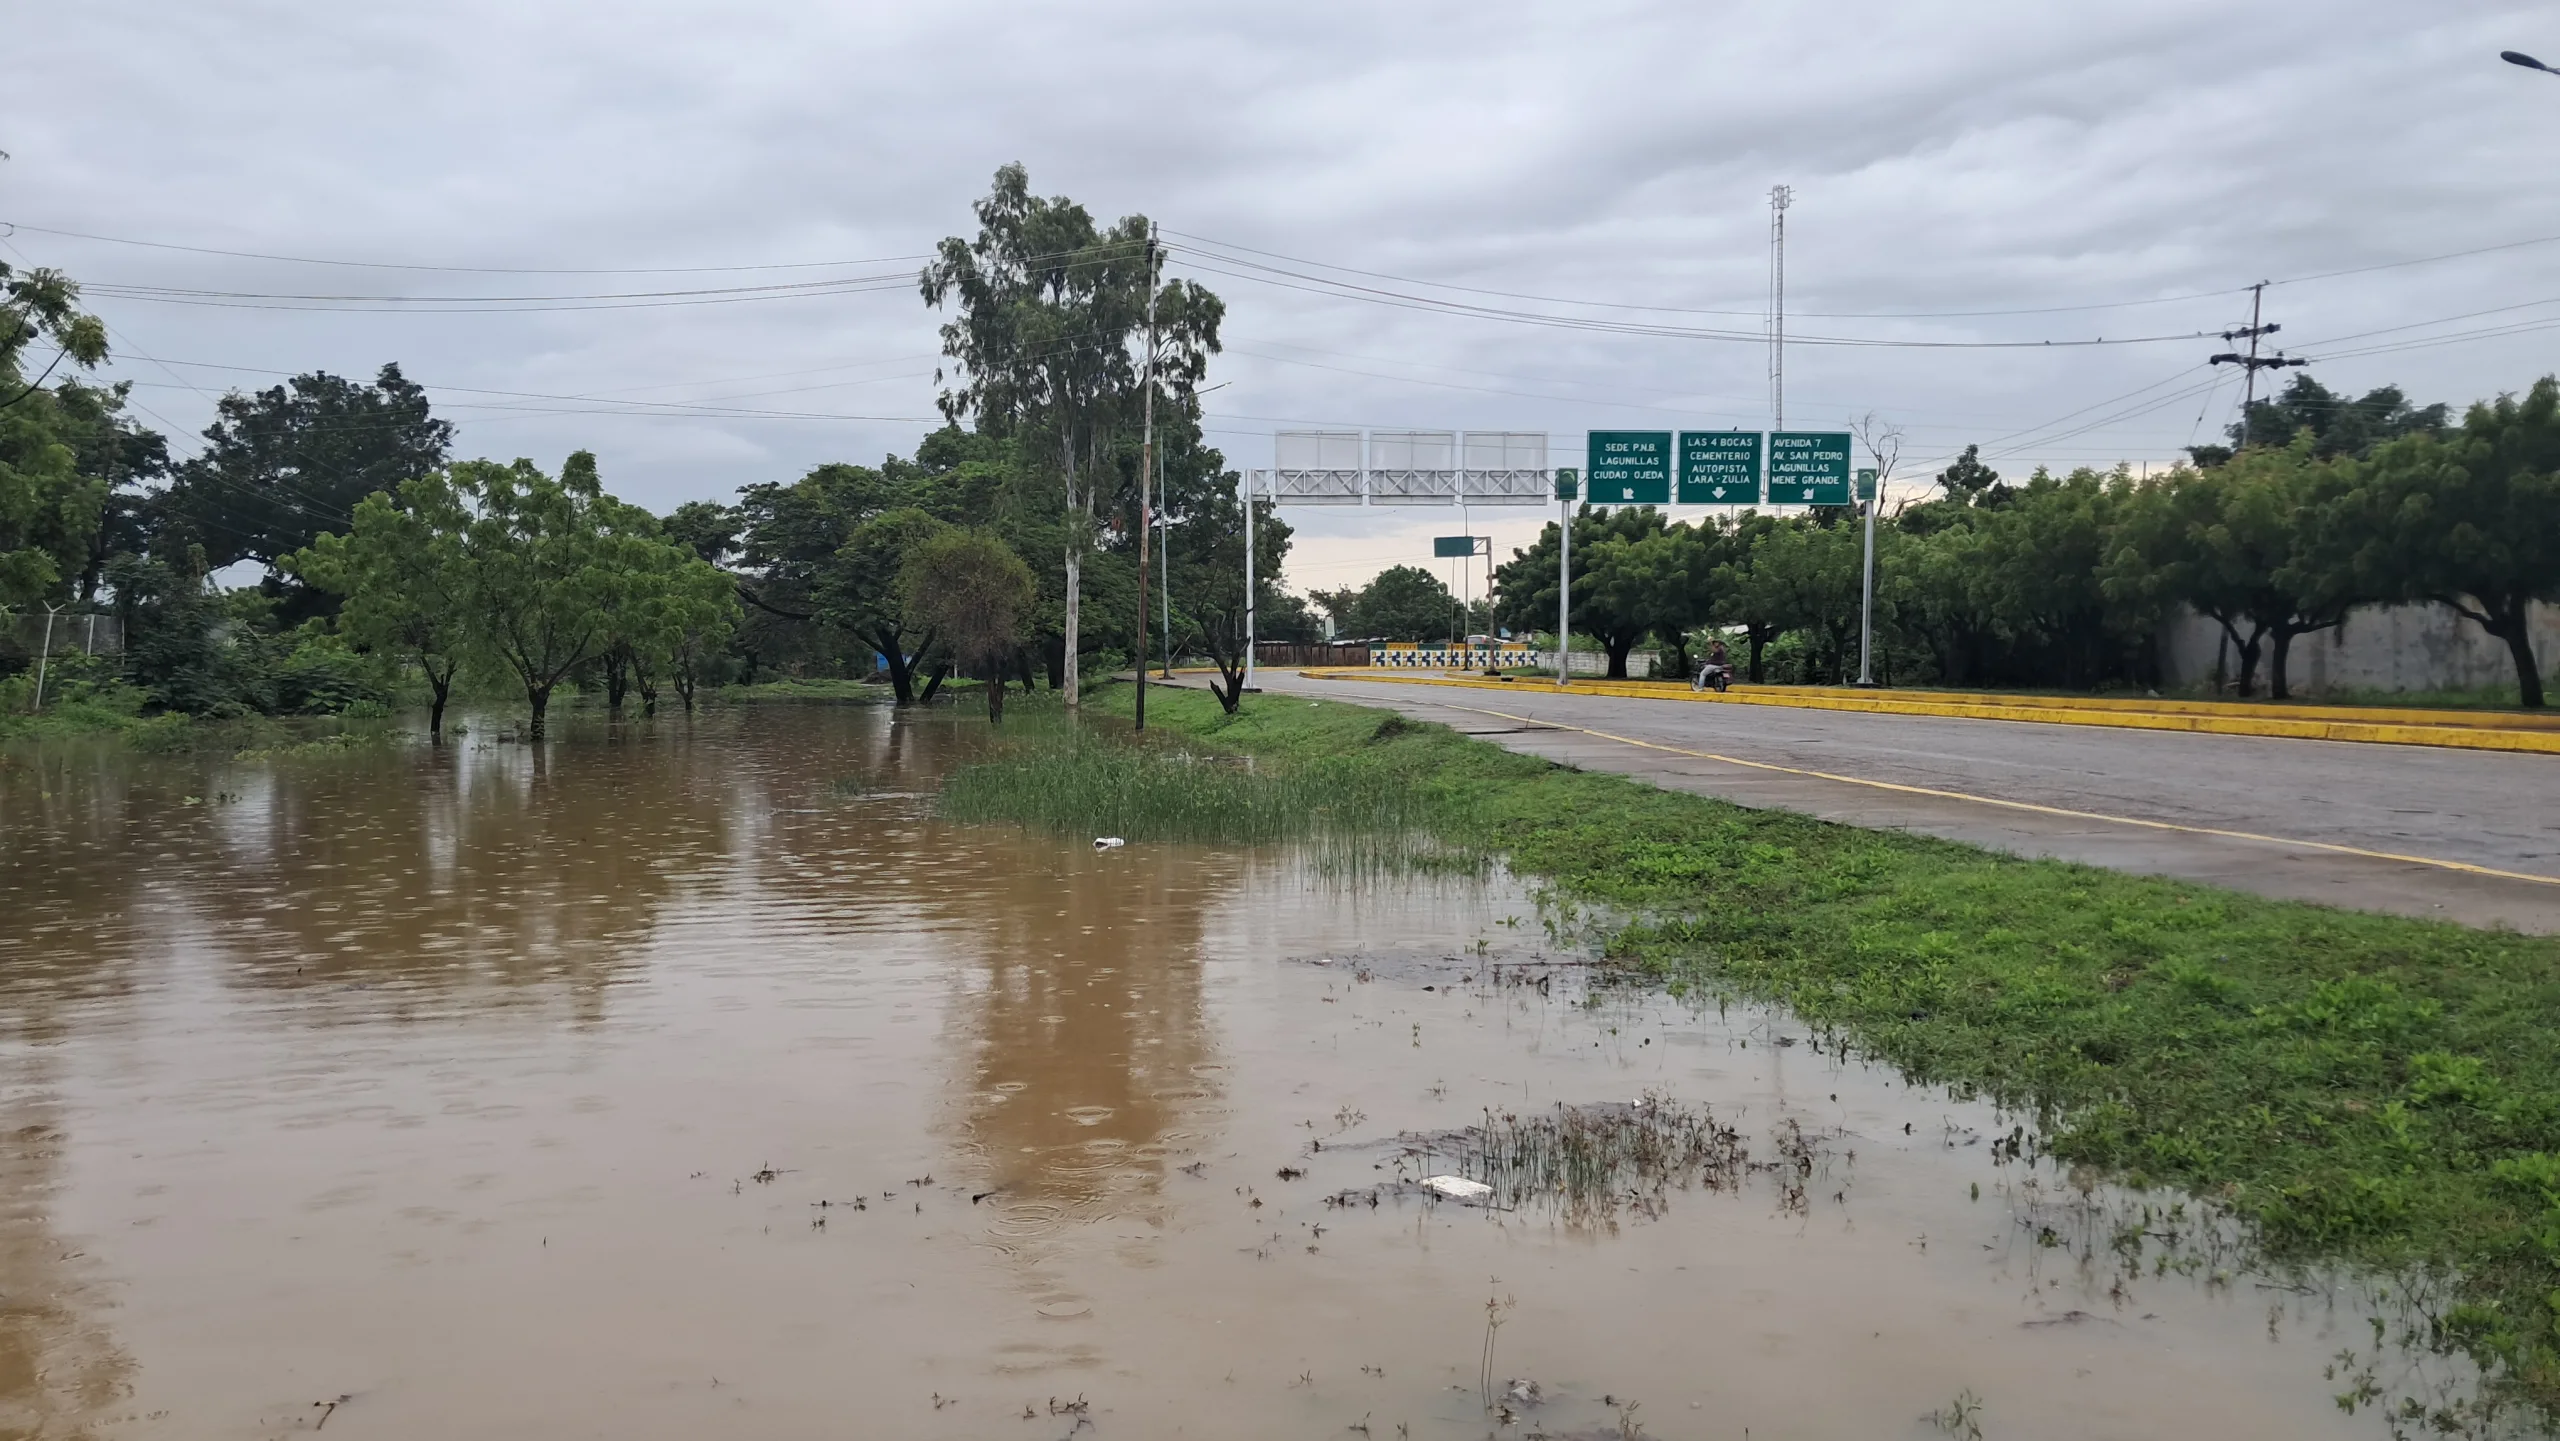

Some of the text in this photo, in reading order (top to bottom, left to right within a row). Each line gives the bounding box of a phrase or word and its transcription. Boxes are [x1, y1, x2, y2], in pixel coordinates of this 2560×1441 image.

[1687, 438, 1753, 447] LAS 4 BOCAS
[1773, 439, 1821, 448] AVENIDA 7
[1604, 443, 1629, 452] SEDE
[1689, 451, 1751, 460] CEMENTERIO
[1790, 451, 1809, 460] SAN
[1813, 451, 1843, 460] PEDRO
[1599, 456, 1660, 465] LAGUNILLAS
[1691, 464, 1748, 473] AUTOPISTA
[1772, 463, 1830, 472] LAGUNILLAS
[1593, 471, 1664, 480] CIUDAD OJEDA
[1687, 475, 1714, 484] LARA
[1771, 476, 1840, 485] MENE GRANDE
